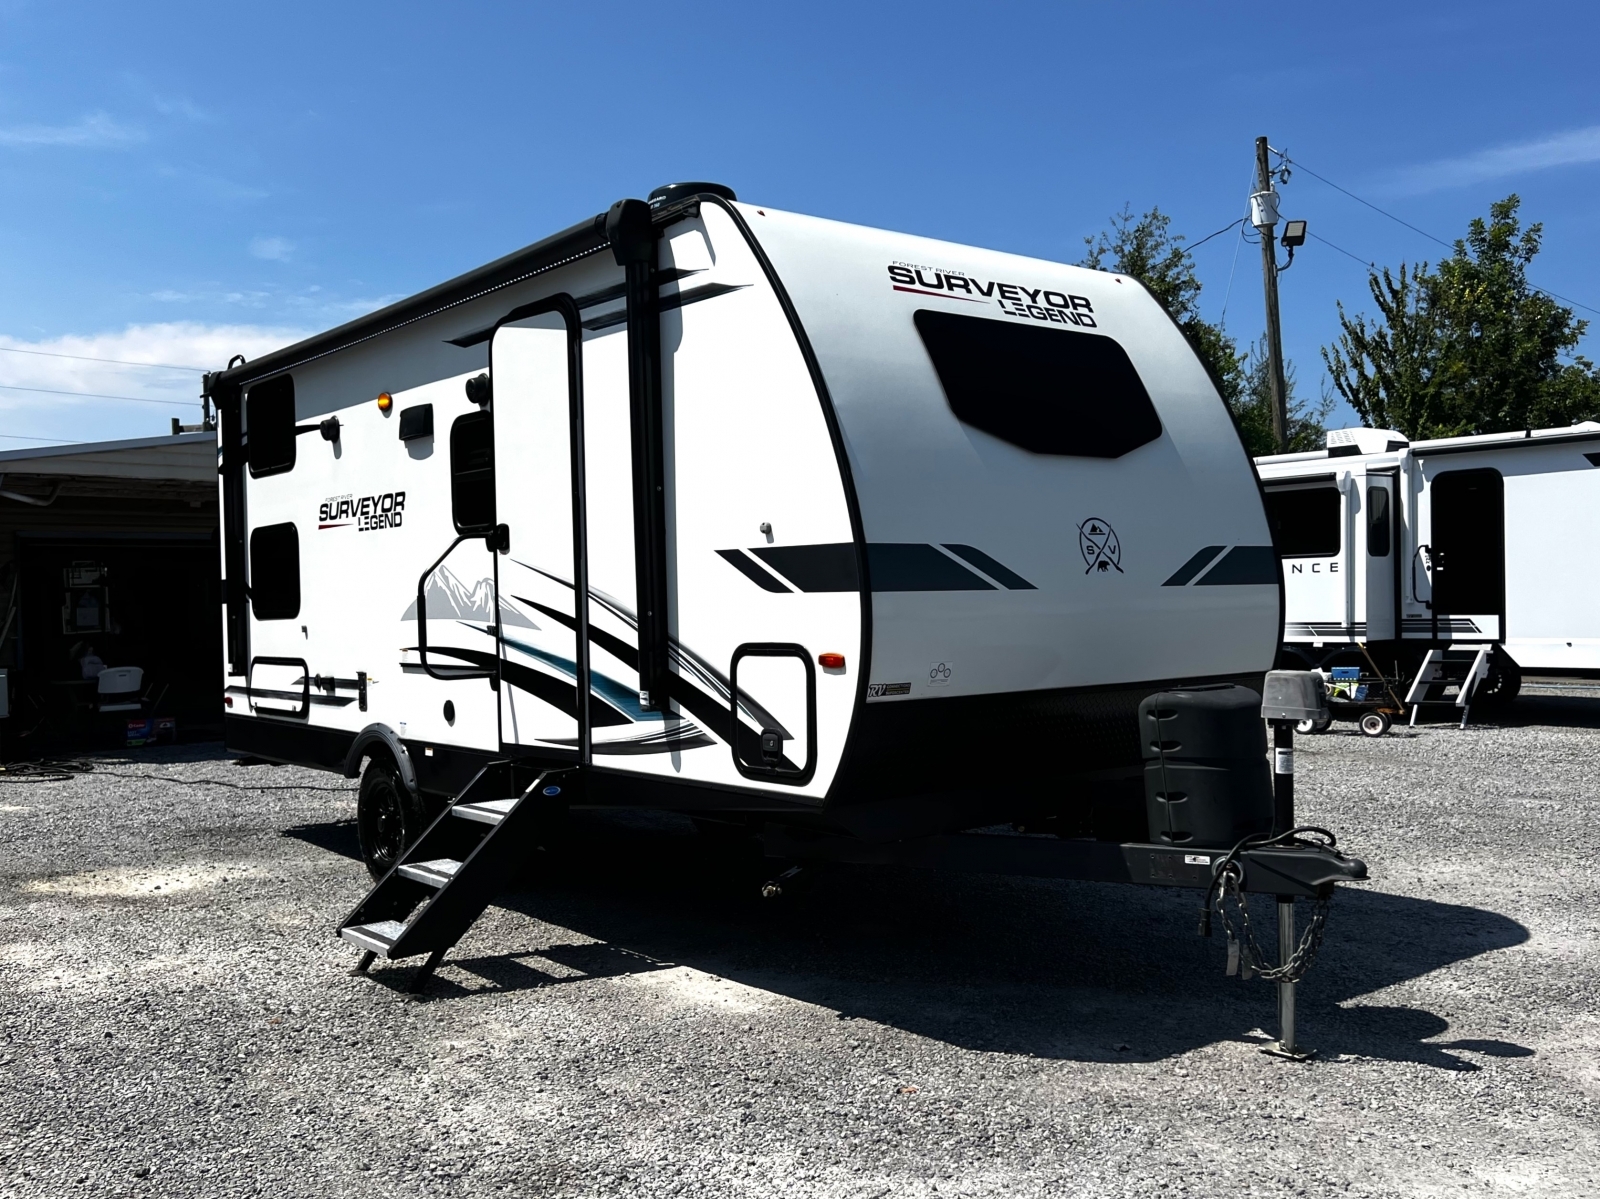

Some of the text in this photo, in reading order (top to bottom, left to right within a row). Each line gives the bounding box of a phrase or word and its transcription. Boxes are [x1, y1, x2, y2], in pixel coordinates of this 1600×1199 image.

[892, 261, 965, 276] FOREST RIVER
[887, 265, 1095, 313] SURVEYOR
[997, 299, 1098, 328] LEGEND
[318, 491, 406, 521] SURVEYOR
[358, 511, 402, 532] LEGEND
[868, 683, 886, 697] RV
